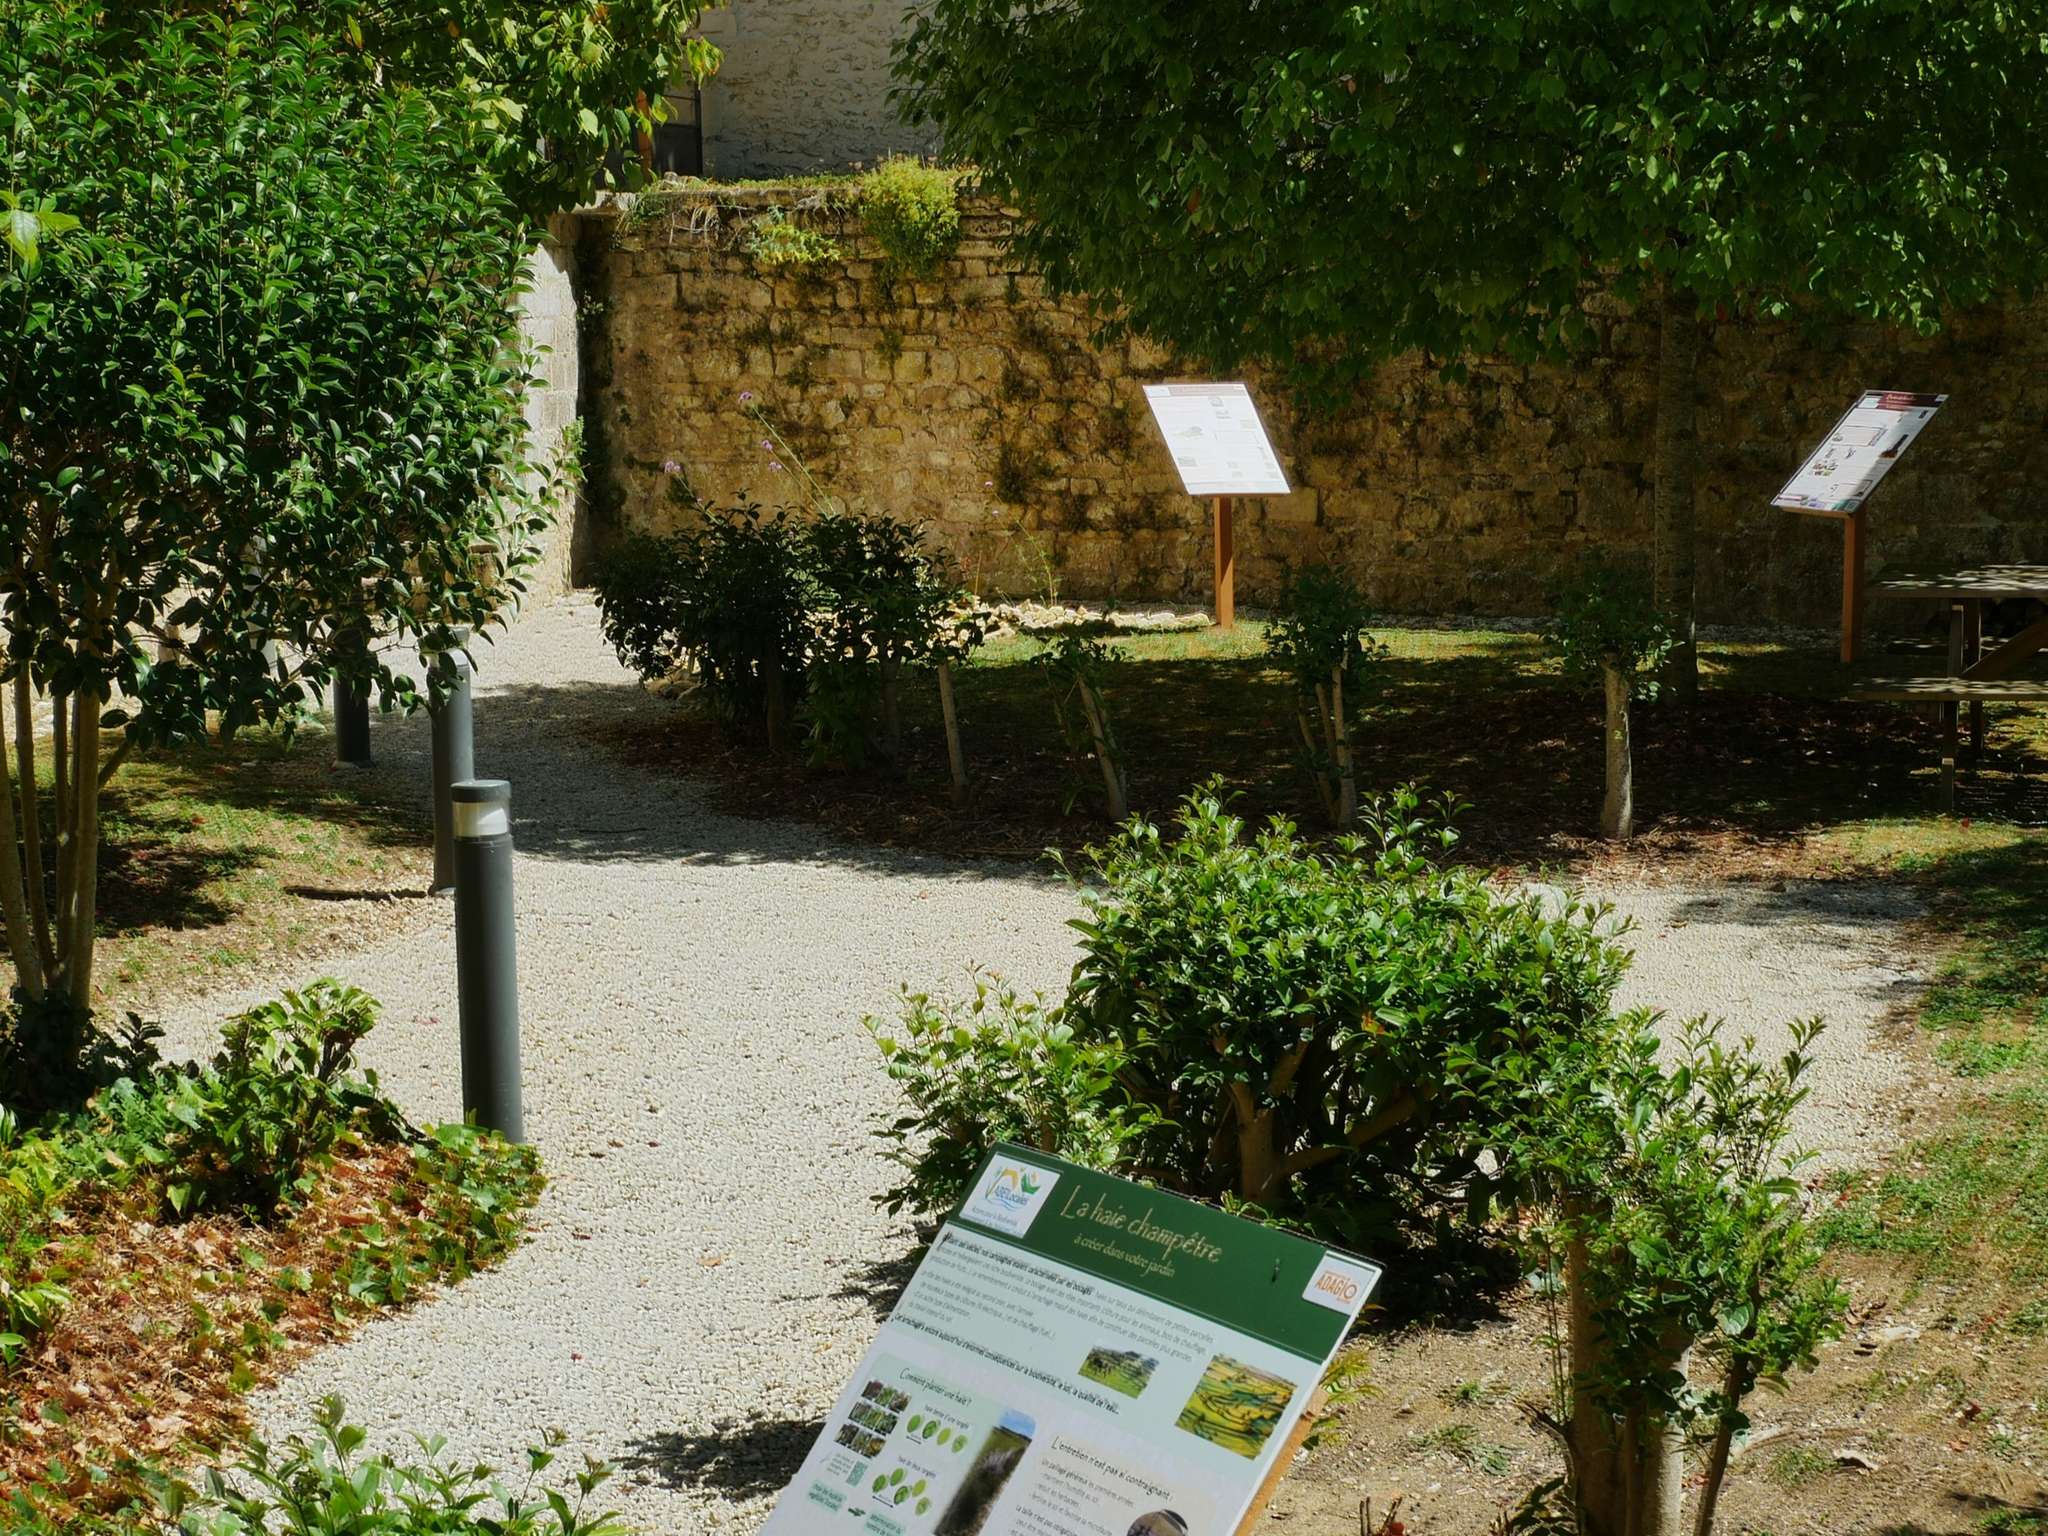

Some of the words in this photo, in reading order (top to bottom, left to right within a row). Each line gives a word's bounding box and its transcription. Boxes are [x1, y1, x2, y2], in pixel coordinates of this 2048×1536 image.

[1060, 1185, 1089, 1218] La
[1090, 1193, 1127, 1229] haie
[1128, 1207, 1223, 1263] champêtre
[1074, 1233, 1082, 1244] à
[1081, 1237, 1103, 1250] créer
[1103, 1240, 1125, 1260] dans
[1125, 1252, 1148, 1269] votre
[1140, 1259, 1175, 1278] jardin
[1088, 1455, 1105, 1470] n'est
[1104, 1464, 1118, 1476] pas
